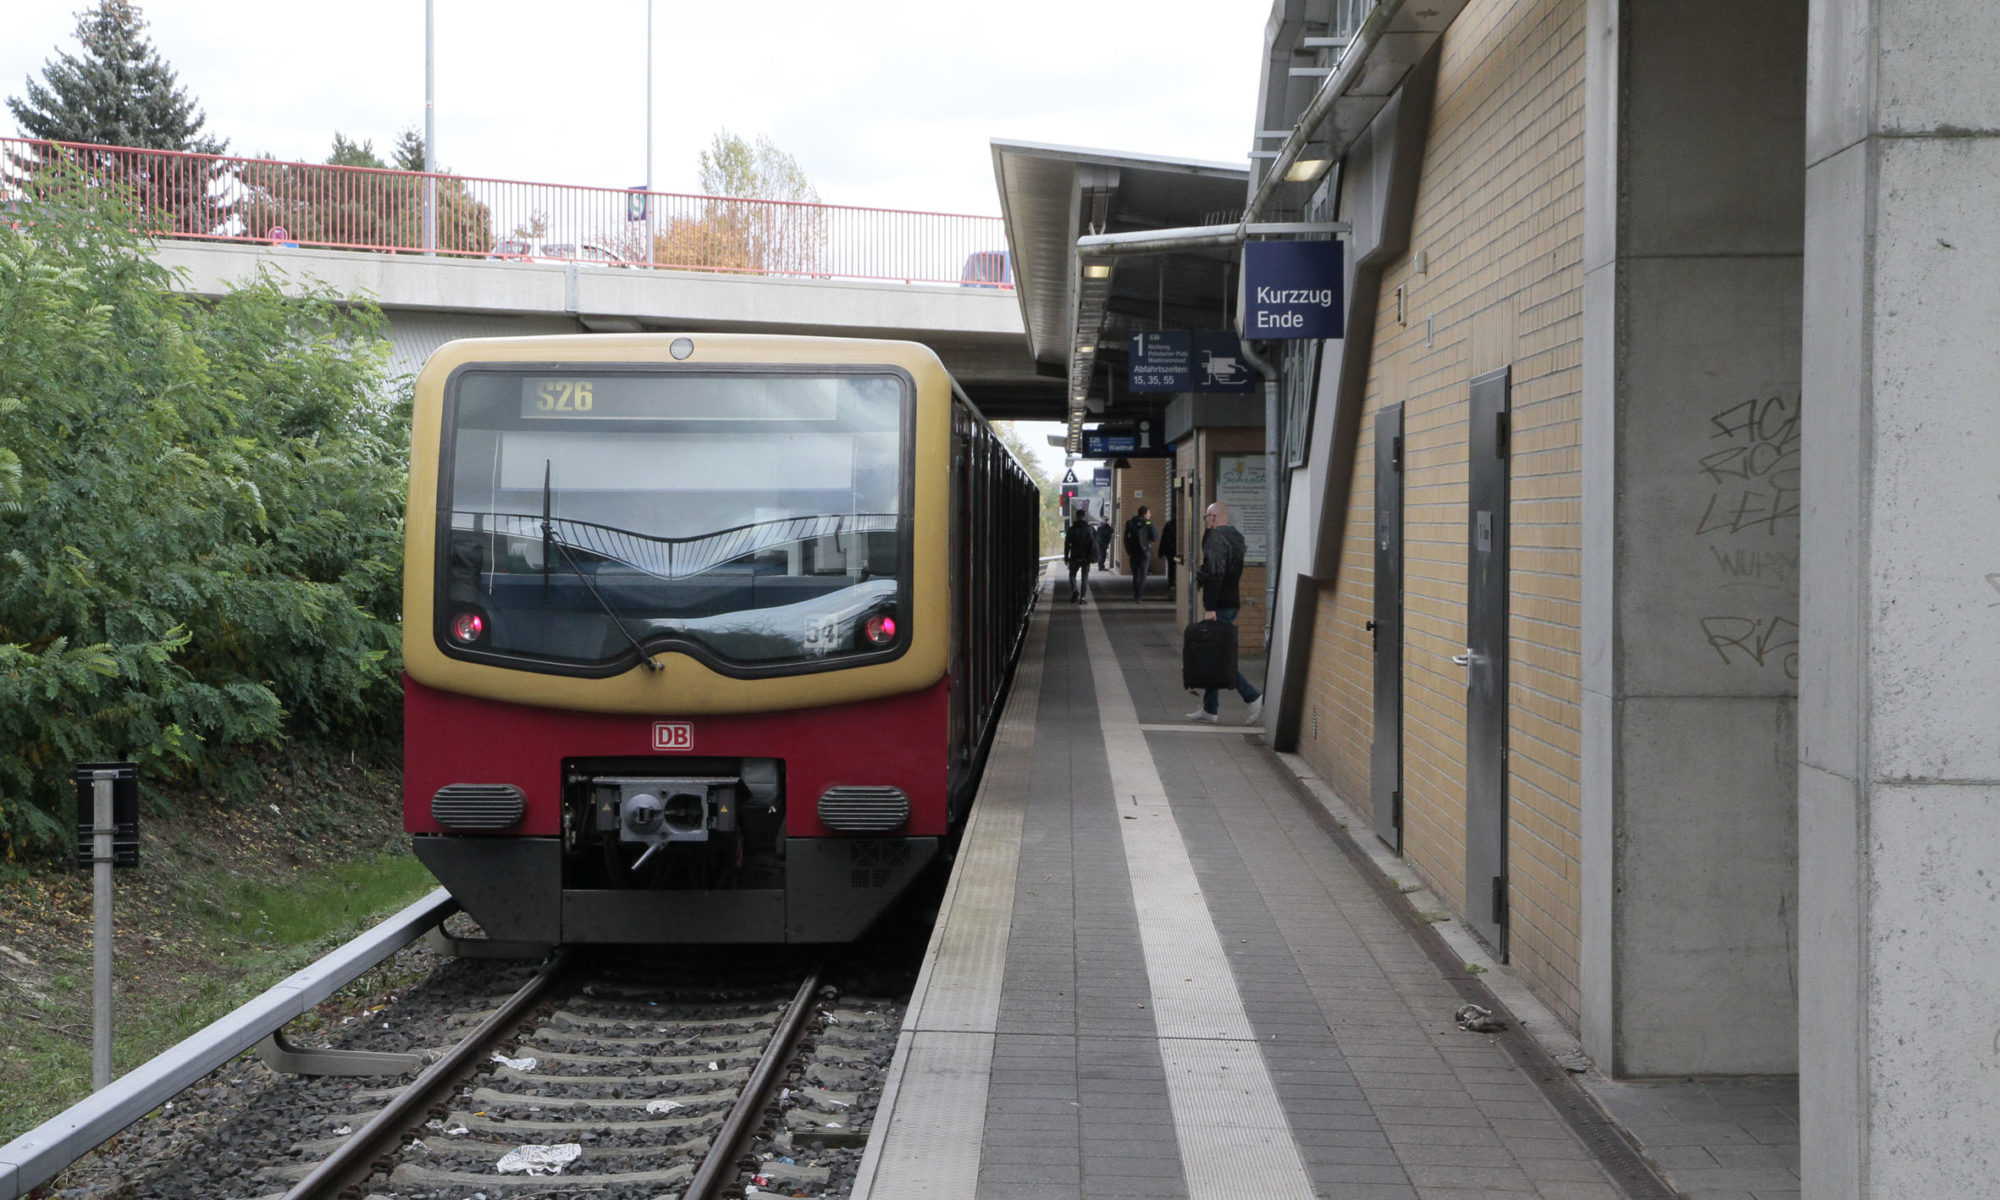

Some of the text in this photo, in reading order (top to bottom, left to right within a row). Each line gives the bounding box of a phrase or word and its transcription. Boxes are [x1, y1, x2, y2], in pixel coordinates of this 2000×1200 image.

[1257, 286, 1332, 307] Kurzzug
[1257, 310, 1304, 328] Ende
[1133, 333, 1143, 356] 1
[1133, 365, 1188, 373] Abfahrtszeiten:
[1133, 376, 1174, 385] 15, 35, 55
[536, 381, 593, 411] S26
[1067, 472, 1074, 482] 6
[658, 726, 689, 746] DB
